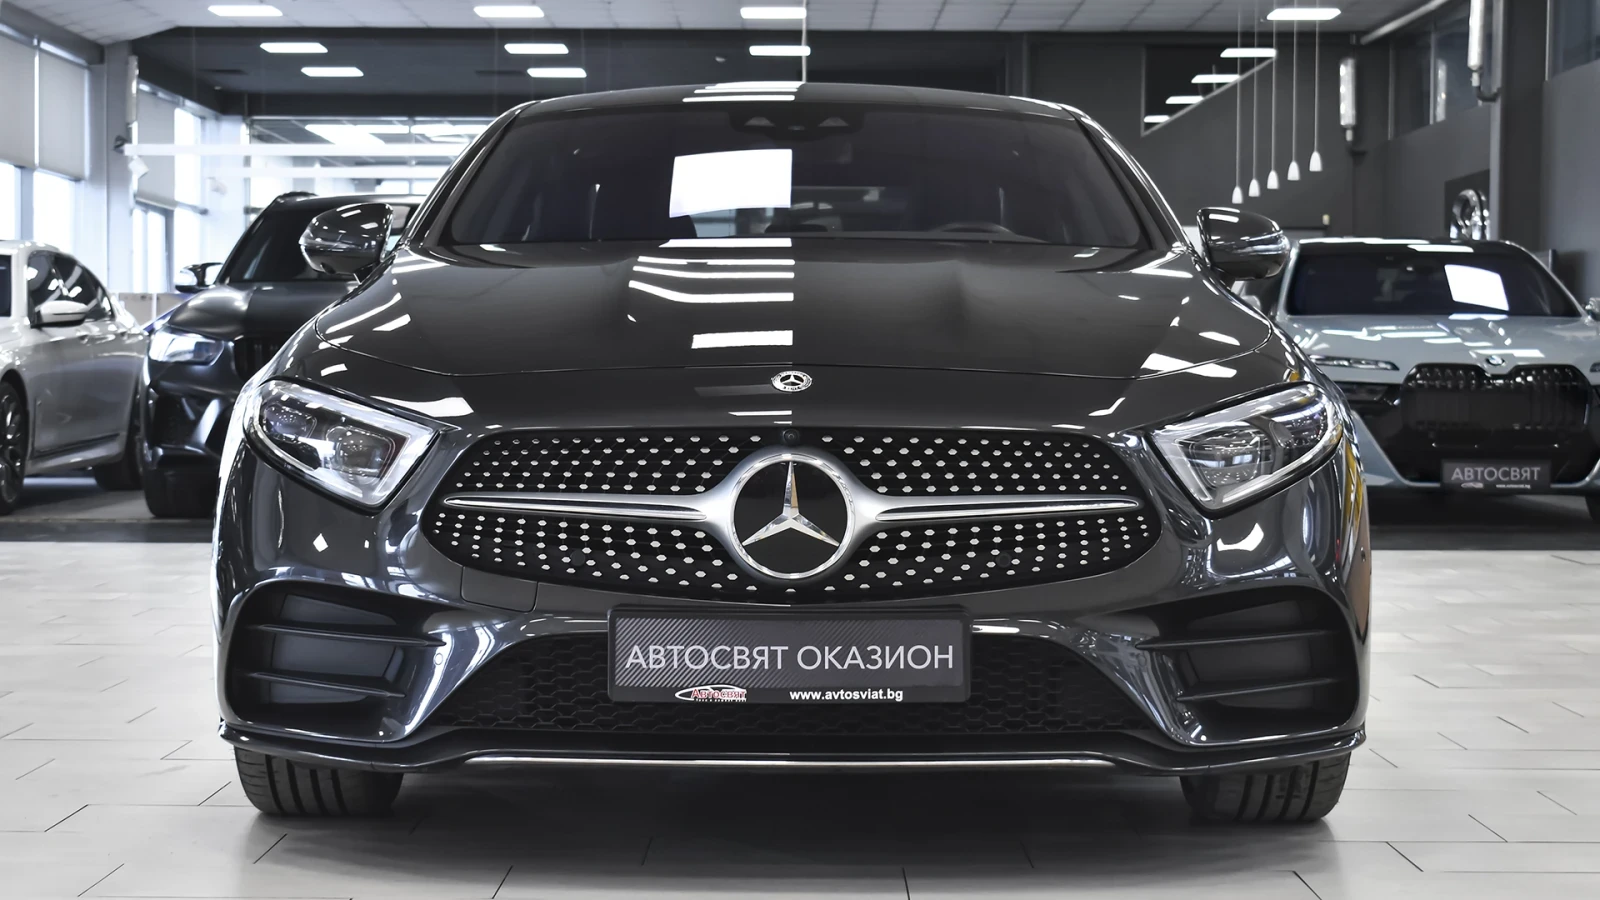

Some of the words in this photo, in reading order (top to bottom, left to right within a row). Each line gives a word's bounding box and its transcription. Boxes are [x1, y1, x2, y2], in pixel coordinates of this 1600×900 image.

[1451, 467, 1541, 481] АВТОСВЯТ
[625, 644, 789, 670] АВТОСВЯТ
[797, 644, 954, 670] ОКАЗИОН
[789, 688, 904, 702] www.avtosviat.bg
